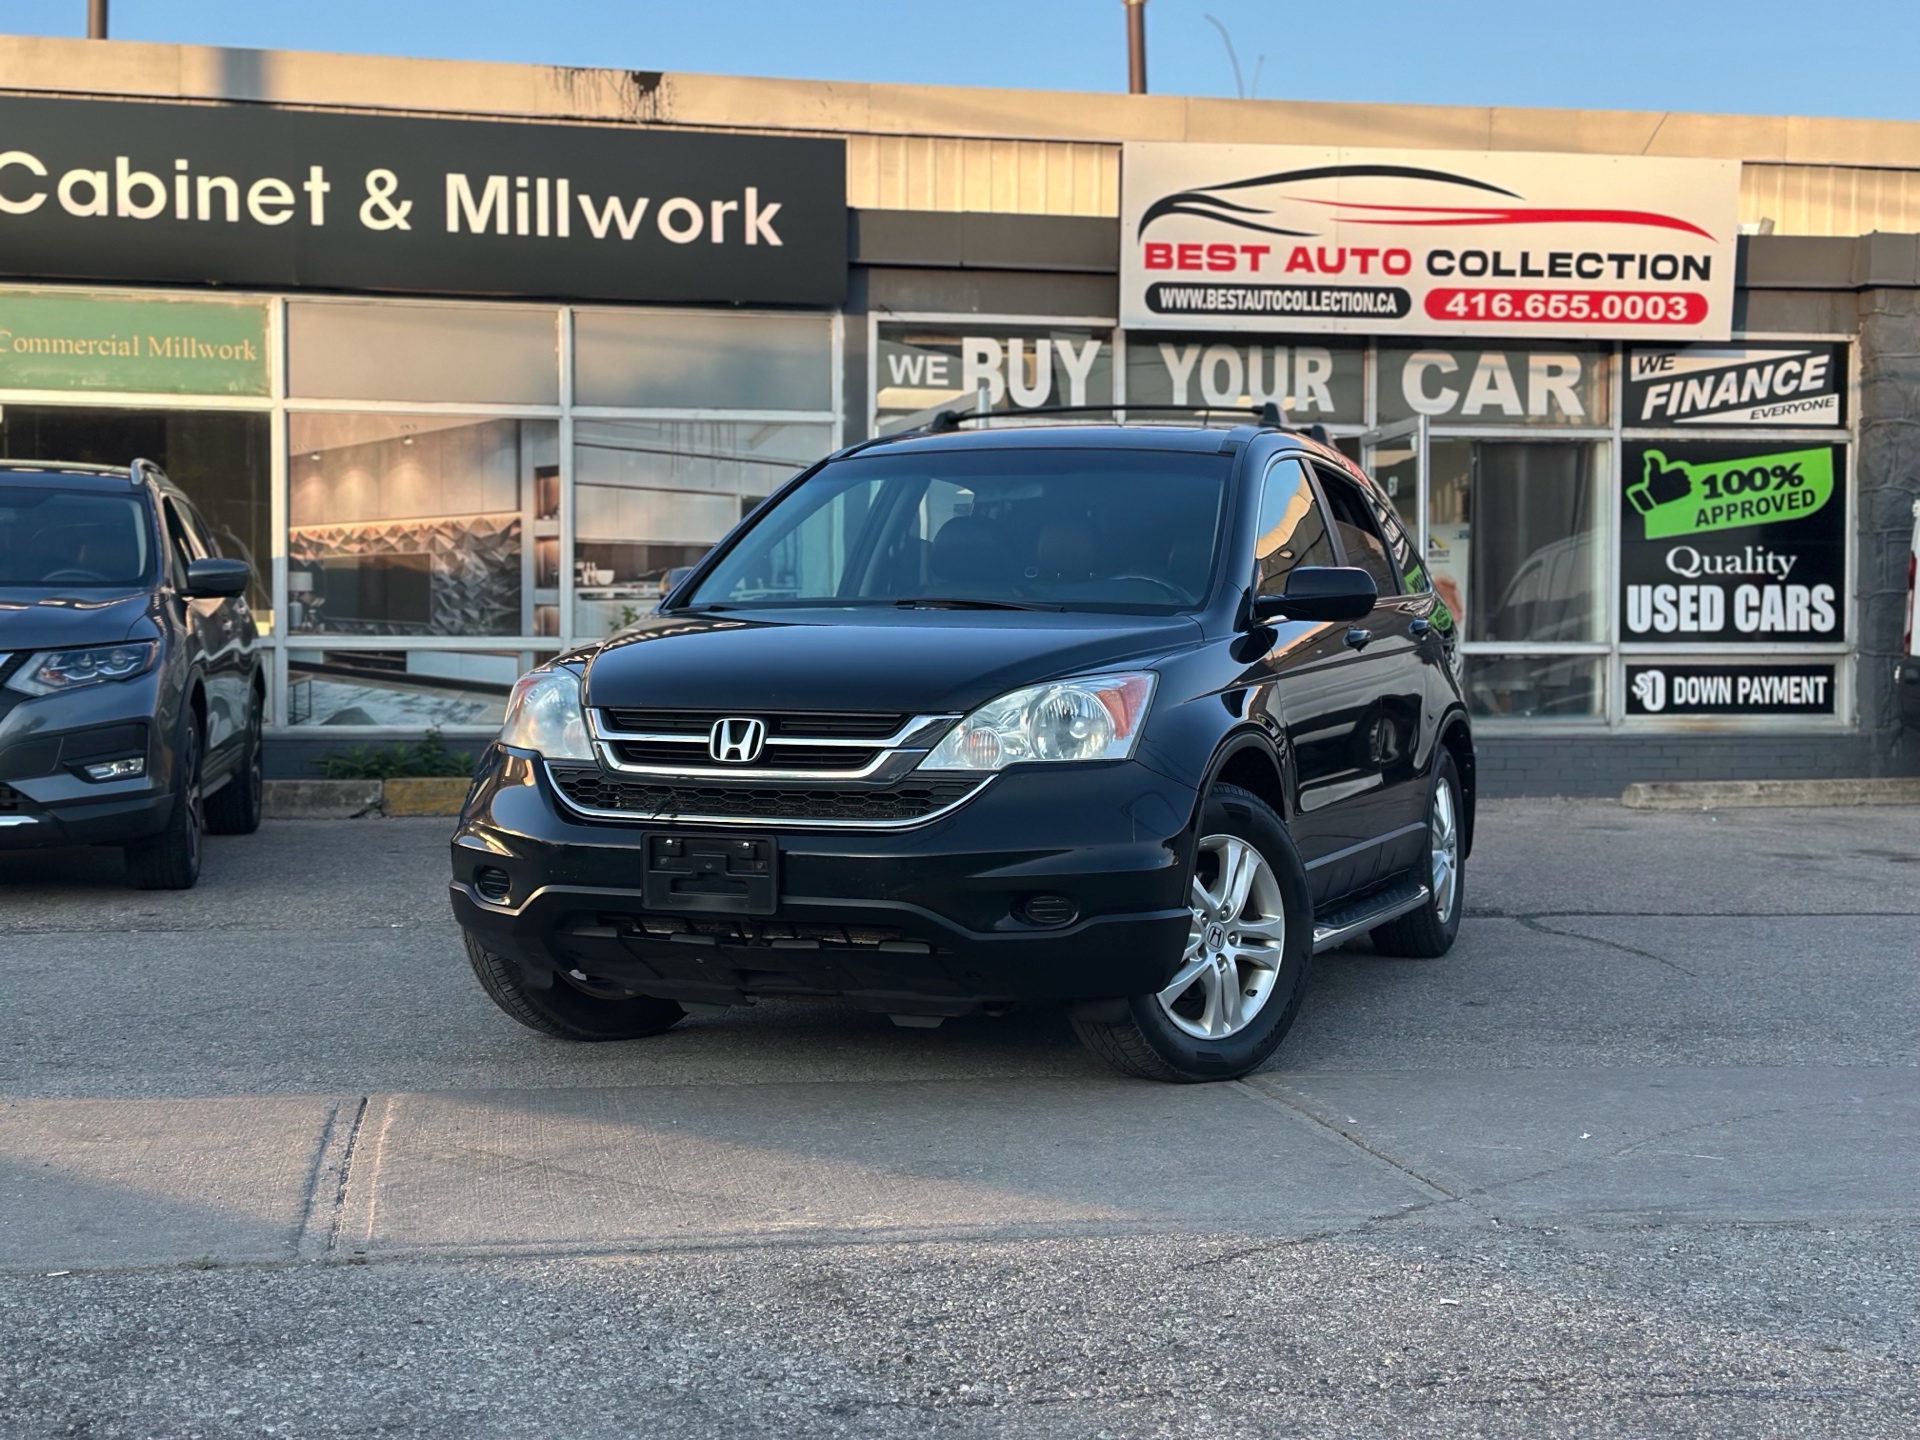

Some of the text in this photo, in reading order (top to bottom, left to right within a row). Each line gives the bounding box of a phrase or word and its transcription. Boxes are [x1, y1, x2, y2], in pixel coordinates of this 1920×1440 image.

[0, 151, 784, 246] Cabinet & Millwork
[1144, 242, 1711, 281] BEST AUTO COLLECTION
[1160, 287, 1397, 314] WWW.BESTAUTOCOLLECTION.CA
[1445, 292, 1688, 321] 416.655.0003
[0, 330, 257, 361] Commercial Millwork
[1637, 353, 1676, 375] WE
[888, 337, 1585, 416] WE BUY YOUR CAR
[1640, 354, 1831, 421] FINANCE
[1749, 396, 1836, 421] EVERYONE
[1701, 462, 1805, 500] 100%
[1694, 488, 1816, 528] APPROVED
[1665, 545, 1798, 580] Quality
[1626, 583, 1836, 633] USED CARS
[1631, 669, 1828, 712] $0 DOWN PAYMENT
